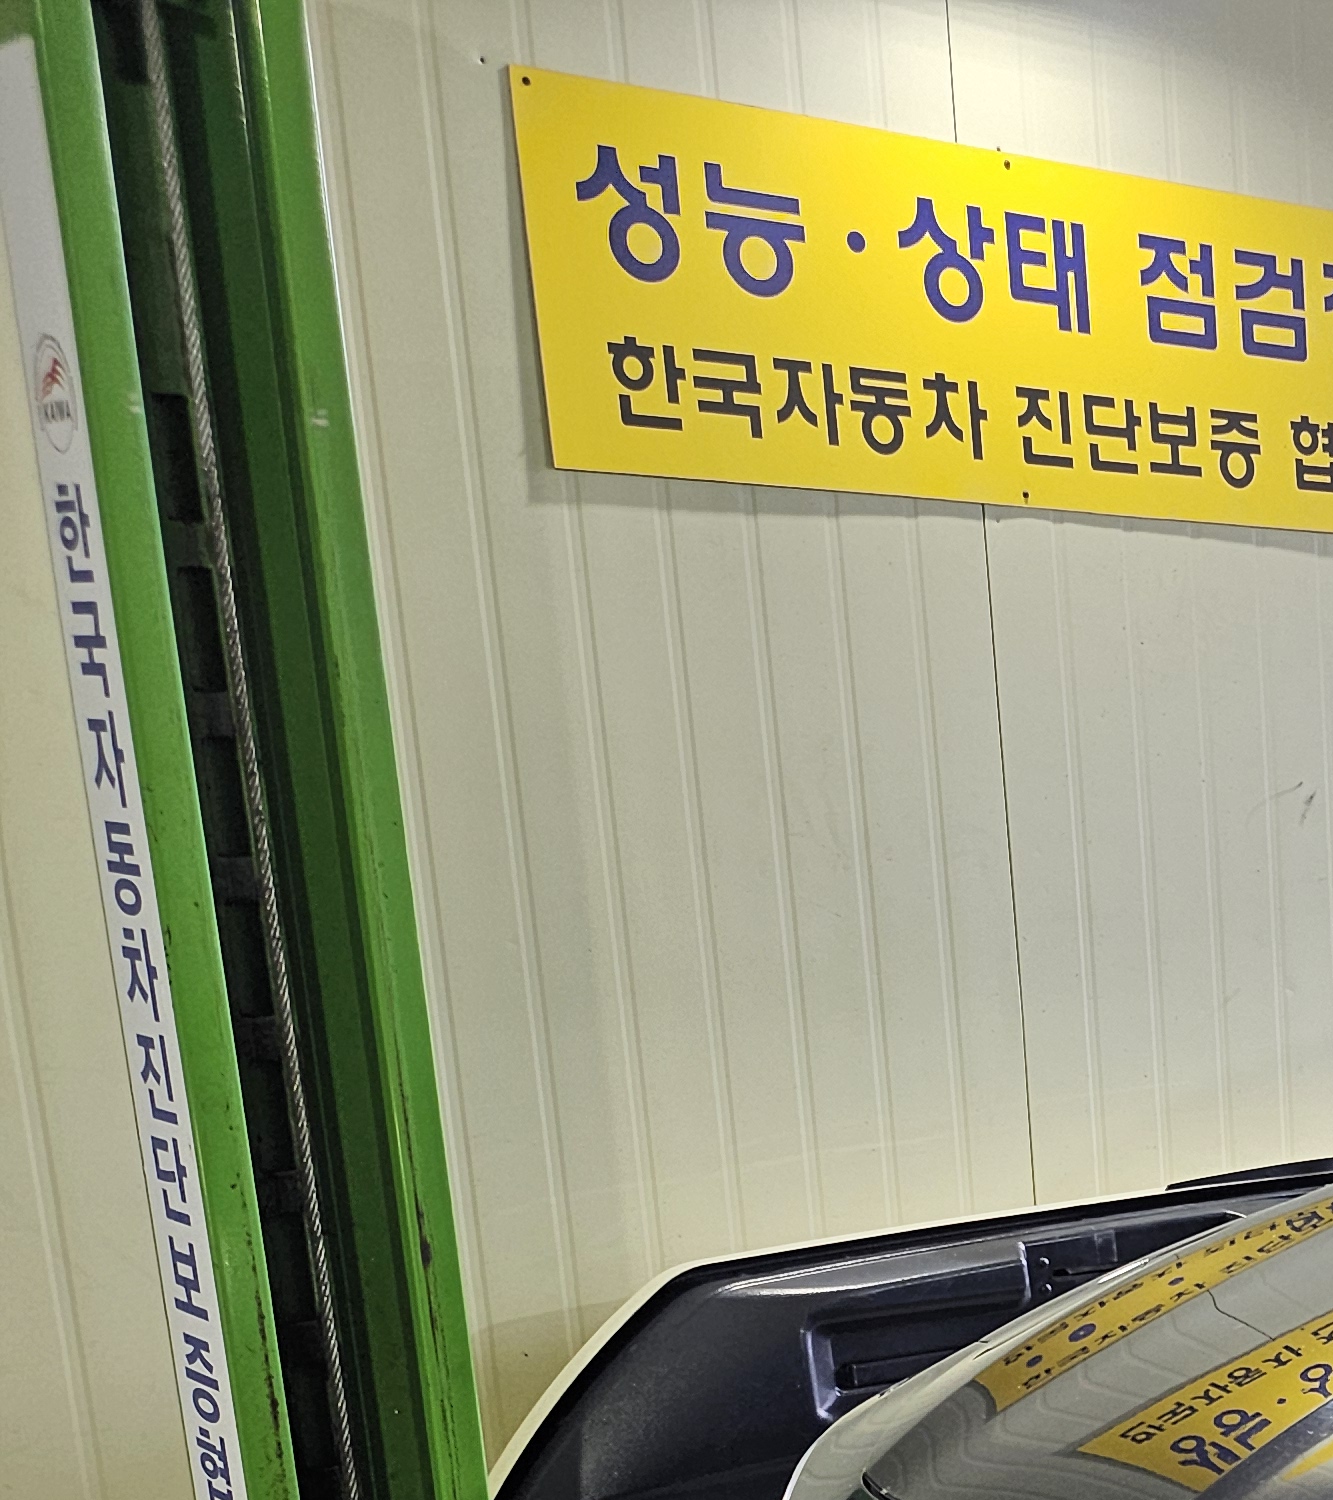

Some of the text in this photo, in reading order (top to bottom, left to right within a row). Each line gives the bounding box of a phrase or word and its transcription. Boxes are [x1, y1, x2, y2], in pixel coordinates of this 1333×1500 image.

[575, 144, 805, 297] 성능
[897, 196, 1091, 335] 상태
[606, 335, 988, 461] 한국자동차
[1015, 385, 1262, 489] 진단보증
